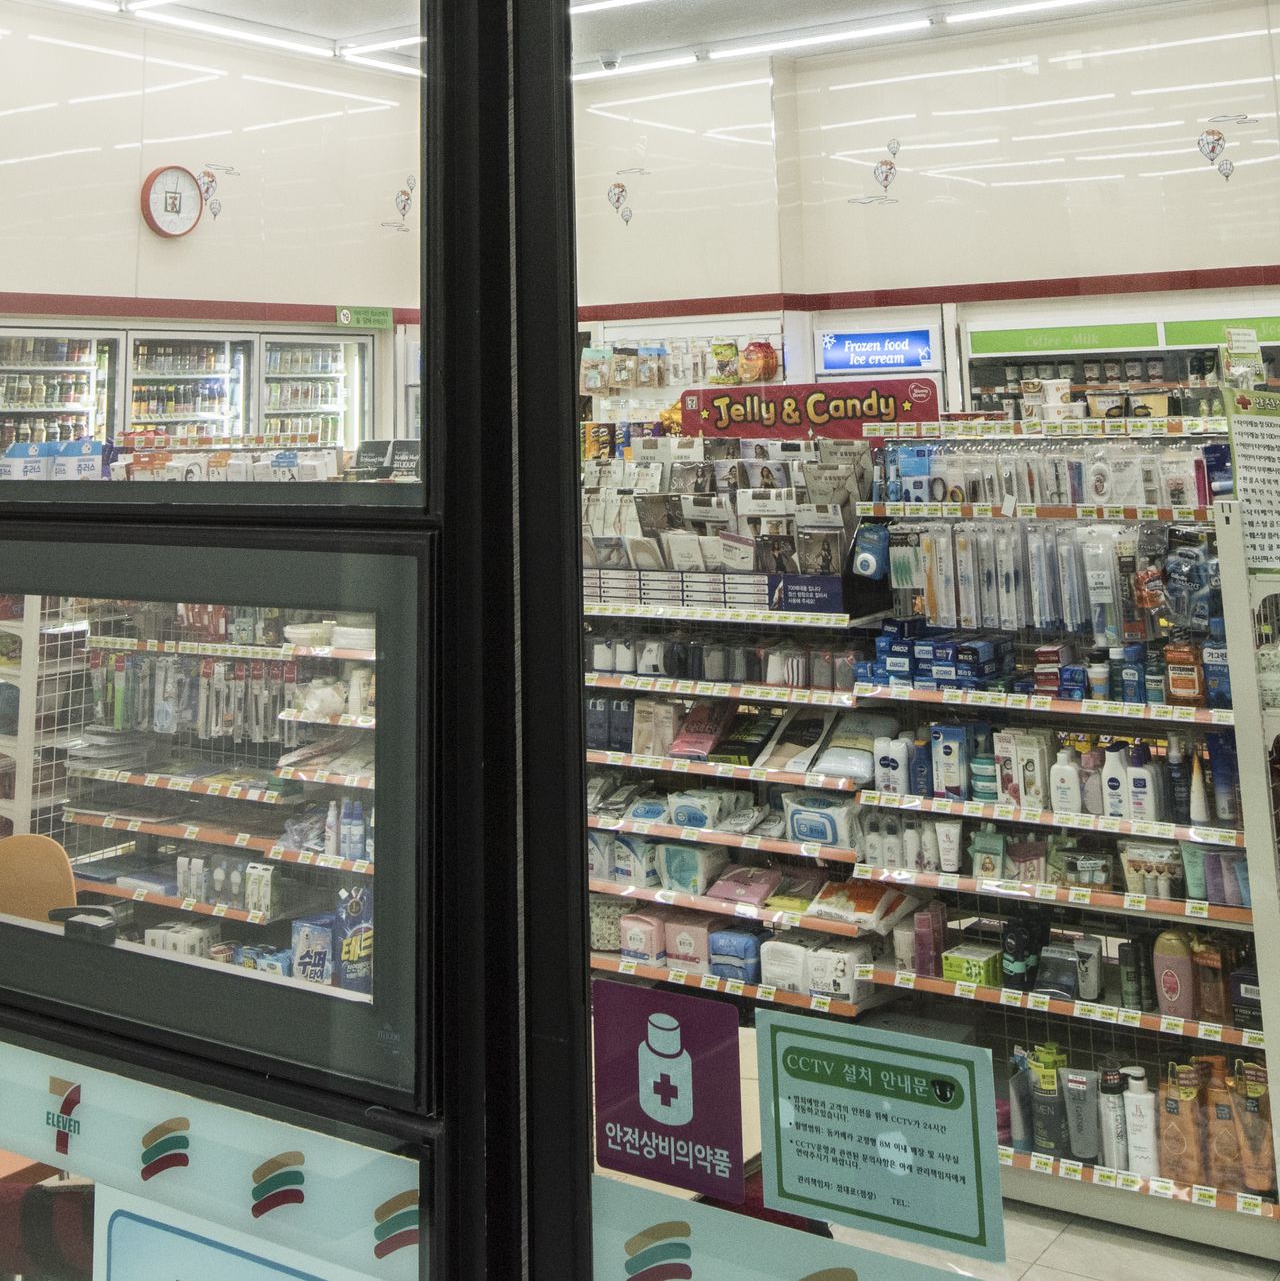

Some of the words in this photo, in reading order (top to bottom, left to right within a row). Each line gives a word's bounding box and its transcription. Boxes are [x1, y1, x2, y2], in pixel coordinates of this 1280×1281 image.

[844, 339, 881, 352] Frozen
[884, 338, 909, 351] food
[849, 353, 866, 365] Ice
[868, 355, 905, 364] cream
[713, 394, 776, 429] Jelly
[781, 398, 802, 424] &
[805, 388, 896, 425] Candy
[298, 950, 327, 977] 수퍼
[309, 968, 324, 980] 타이
[787, 1054, 835, 1076] CCTV
[842, 1063, 872, 1087] 설치
[880, 1070, 929, 1097] 안내문
[829, 1101, 849, 1114] 고객의
[851, 1106, 871, 1119] 안전을
[874, 1110, 888, 1122] 위해
[891, 1114, 921, 1129] CCTV가
[922, 1121, 947, 1135] 24시간
[605, 1122, 732, 1178] 안전상비의약품
[795, 1139, 836, 1156] CCTV운영과
[839, 1147, 859, 1160] 관련된
[862, 1152, 897, 1169] 문의사항은
[899, 1161, 913, 1173] 아래
[916, 1165, 967, 1185] 관리책임자에게
[826, 1128, 854, 1143] 돔카메라
[893, 1142, 908, 1154] 이내
[927, 1150, 935, 1160] 및
[937, 1151, 959, 1165] 사무실
[797, 1175, 834, 1191] 관리책임자:
[890, 1197, 910, 1208] TEL:
